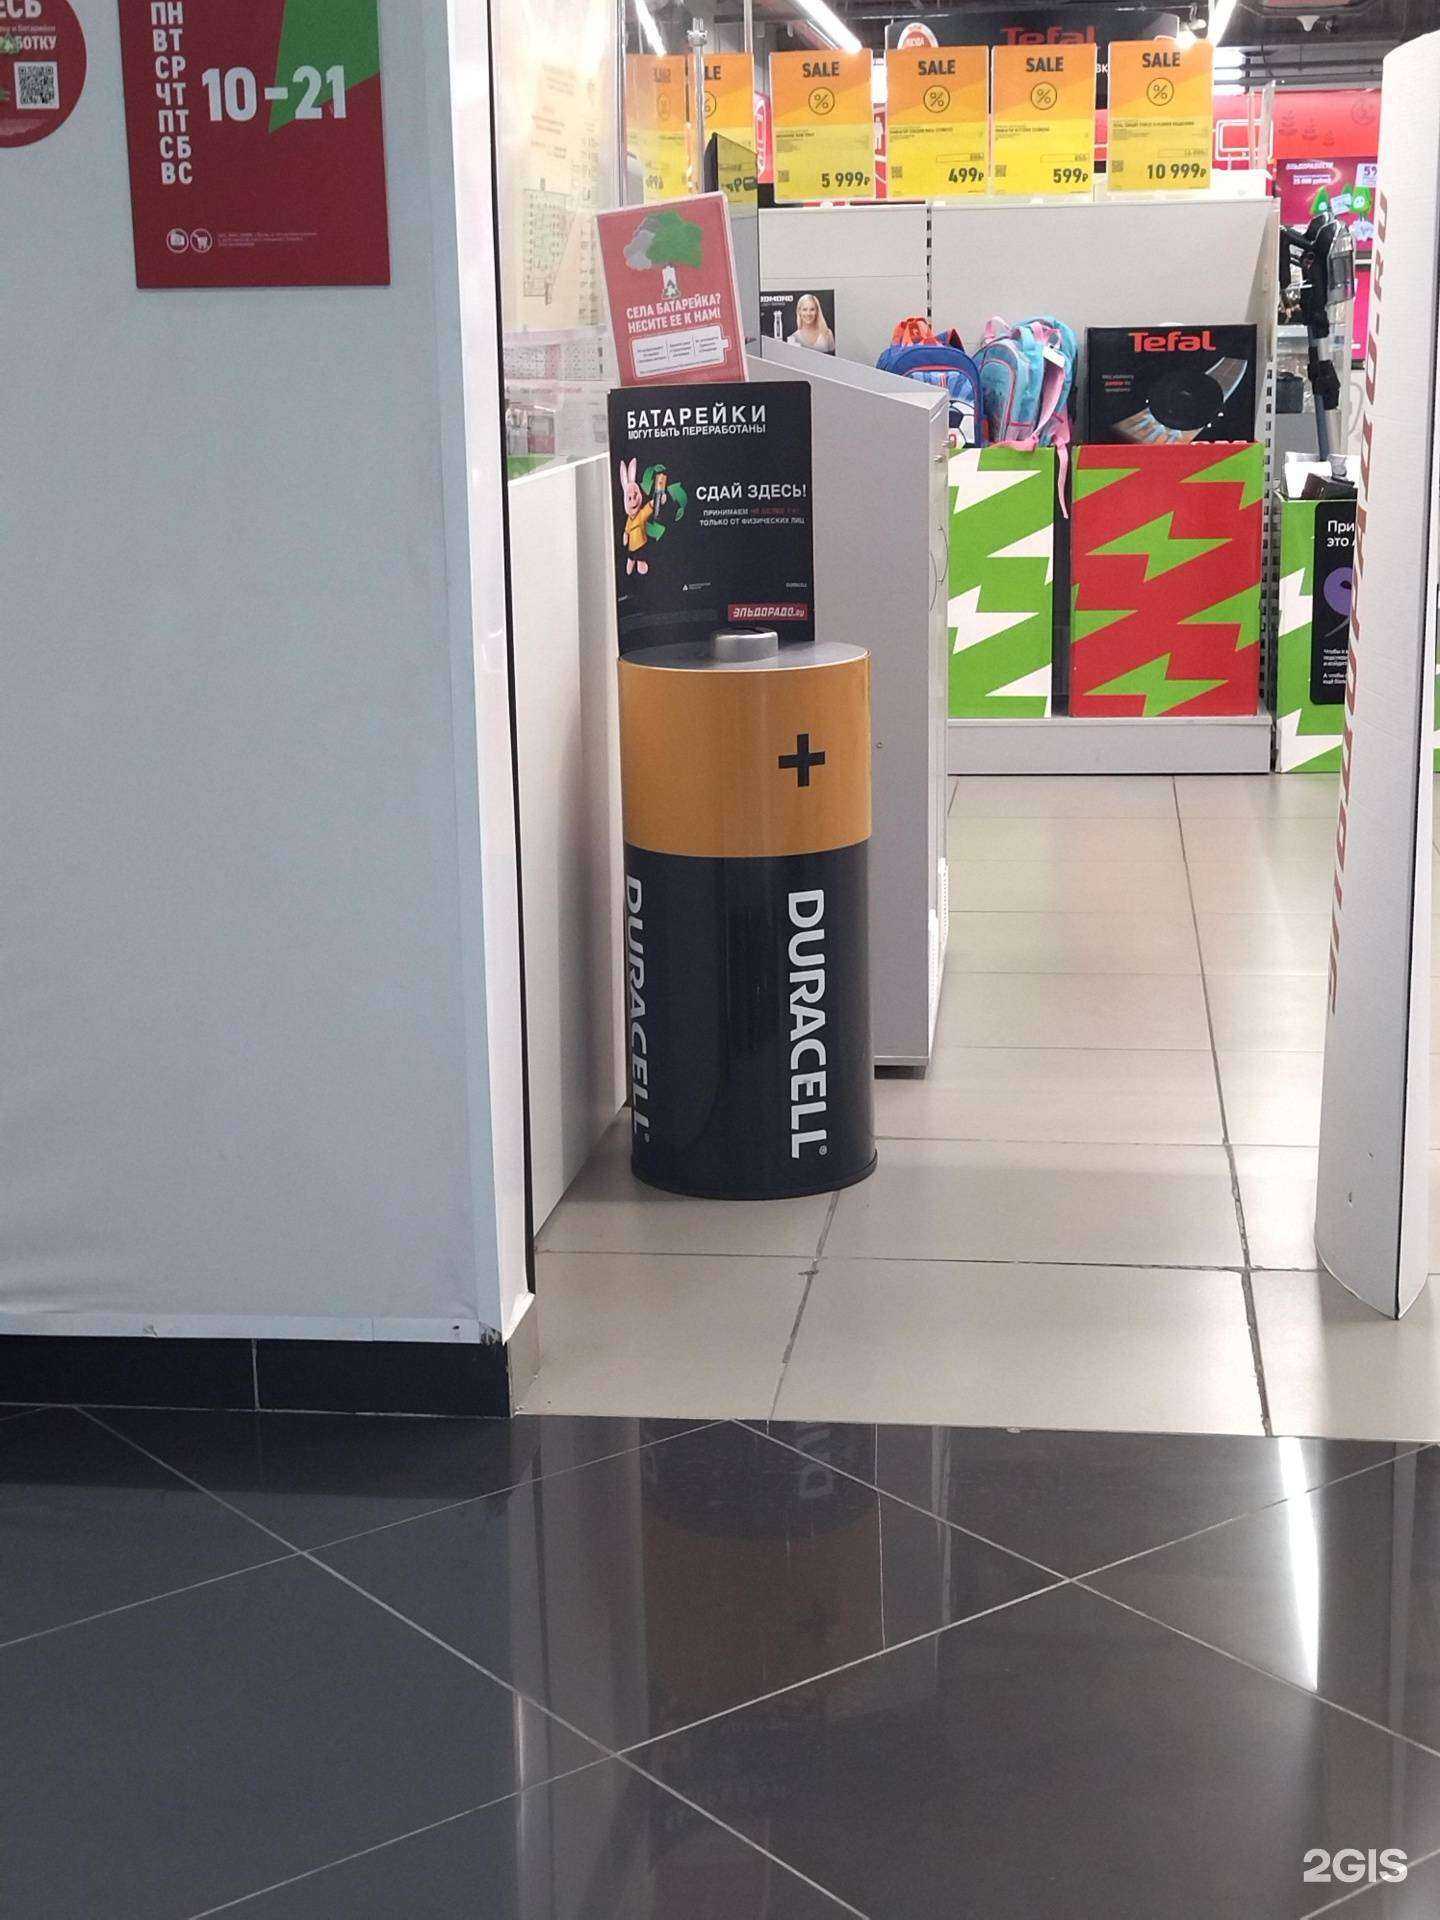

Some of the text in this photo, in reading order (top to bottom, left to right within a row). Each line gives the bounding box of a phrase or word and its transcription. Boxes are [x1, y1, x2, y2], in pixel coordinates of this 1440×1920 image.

[150, 1, 183, 25] ПН
[153, 28, 183, 52] ВТ
[155, 56, 186, 79] СР
[802, 61, 840, 78] SALE
[918, 59, 956, 76] SALE
[1026, 56, 1064, 72] SALE
[1142, 52, 1180, 68] SALE
[704, 66, 721, 80] LE
[156, 82, 186, 106] ЧТ
[158, 109, 189, 132] ПТ
[160, 136, 192, 159] СБ
[161, 161, 193, 185] ВС
[821, 173, 831, 188] 5
[1147, 164, 1166, 179] 10
[626, 293, 721, 319] СЕЛА БАТАРЕЙКА?
[628, 308, 721, 334] НЕСИТЕ ЕЕ К НАМ!
[1128, 330, 1217, 353] Tefal
[627, 402, 766, 429] БАТАРЕЙКИ
[628, 424, 766, 440] МОГУТ БЫТЬ ПЕРЕРАБОТАНЫ
[696, 482, 807, 502] СДАЙ ЗДЕСЬ!
[700, 518, 728, 526] ТОЛЬКО
[703, 508, 748, 516] ПРИНИМАЕМ
[1328, 520, 1355, 534] При
[1327, 537, 1349, 547] это
[788, 889, 828, 1159] DURACELL
